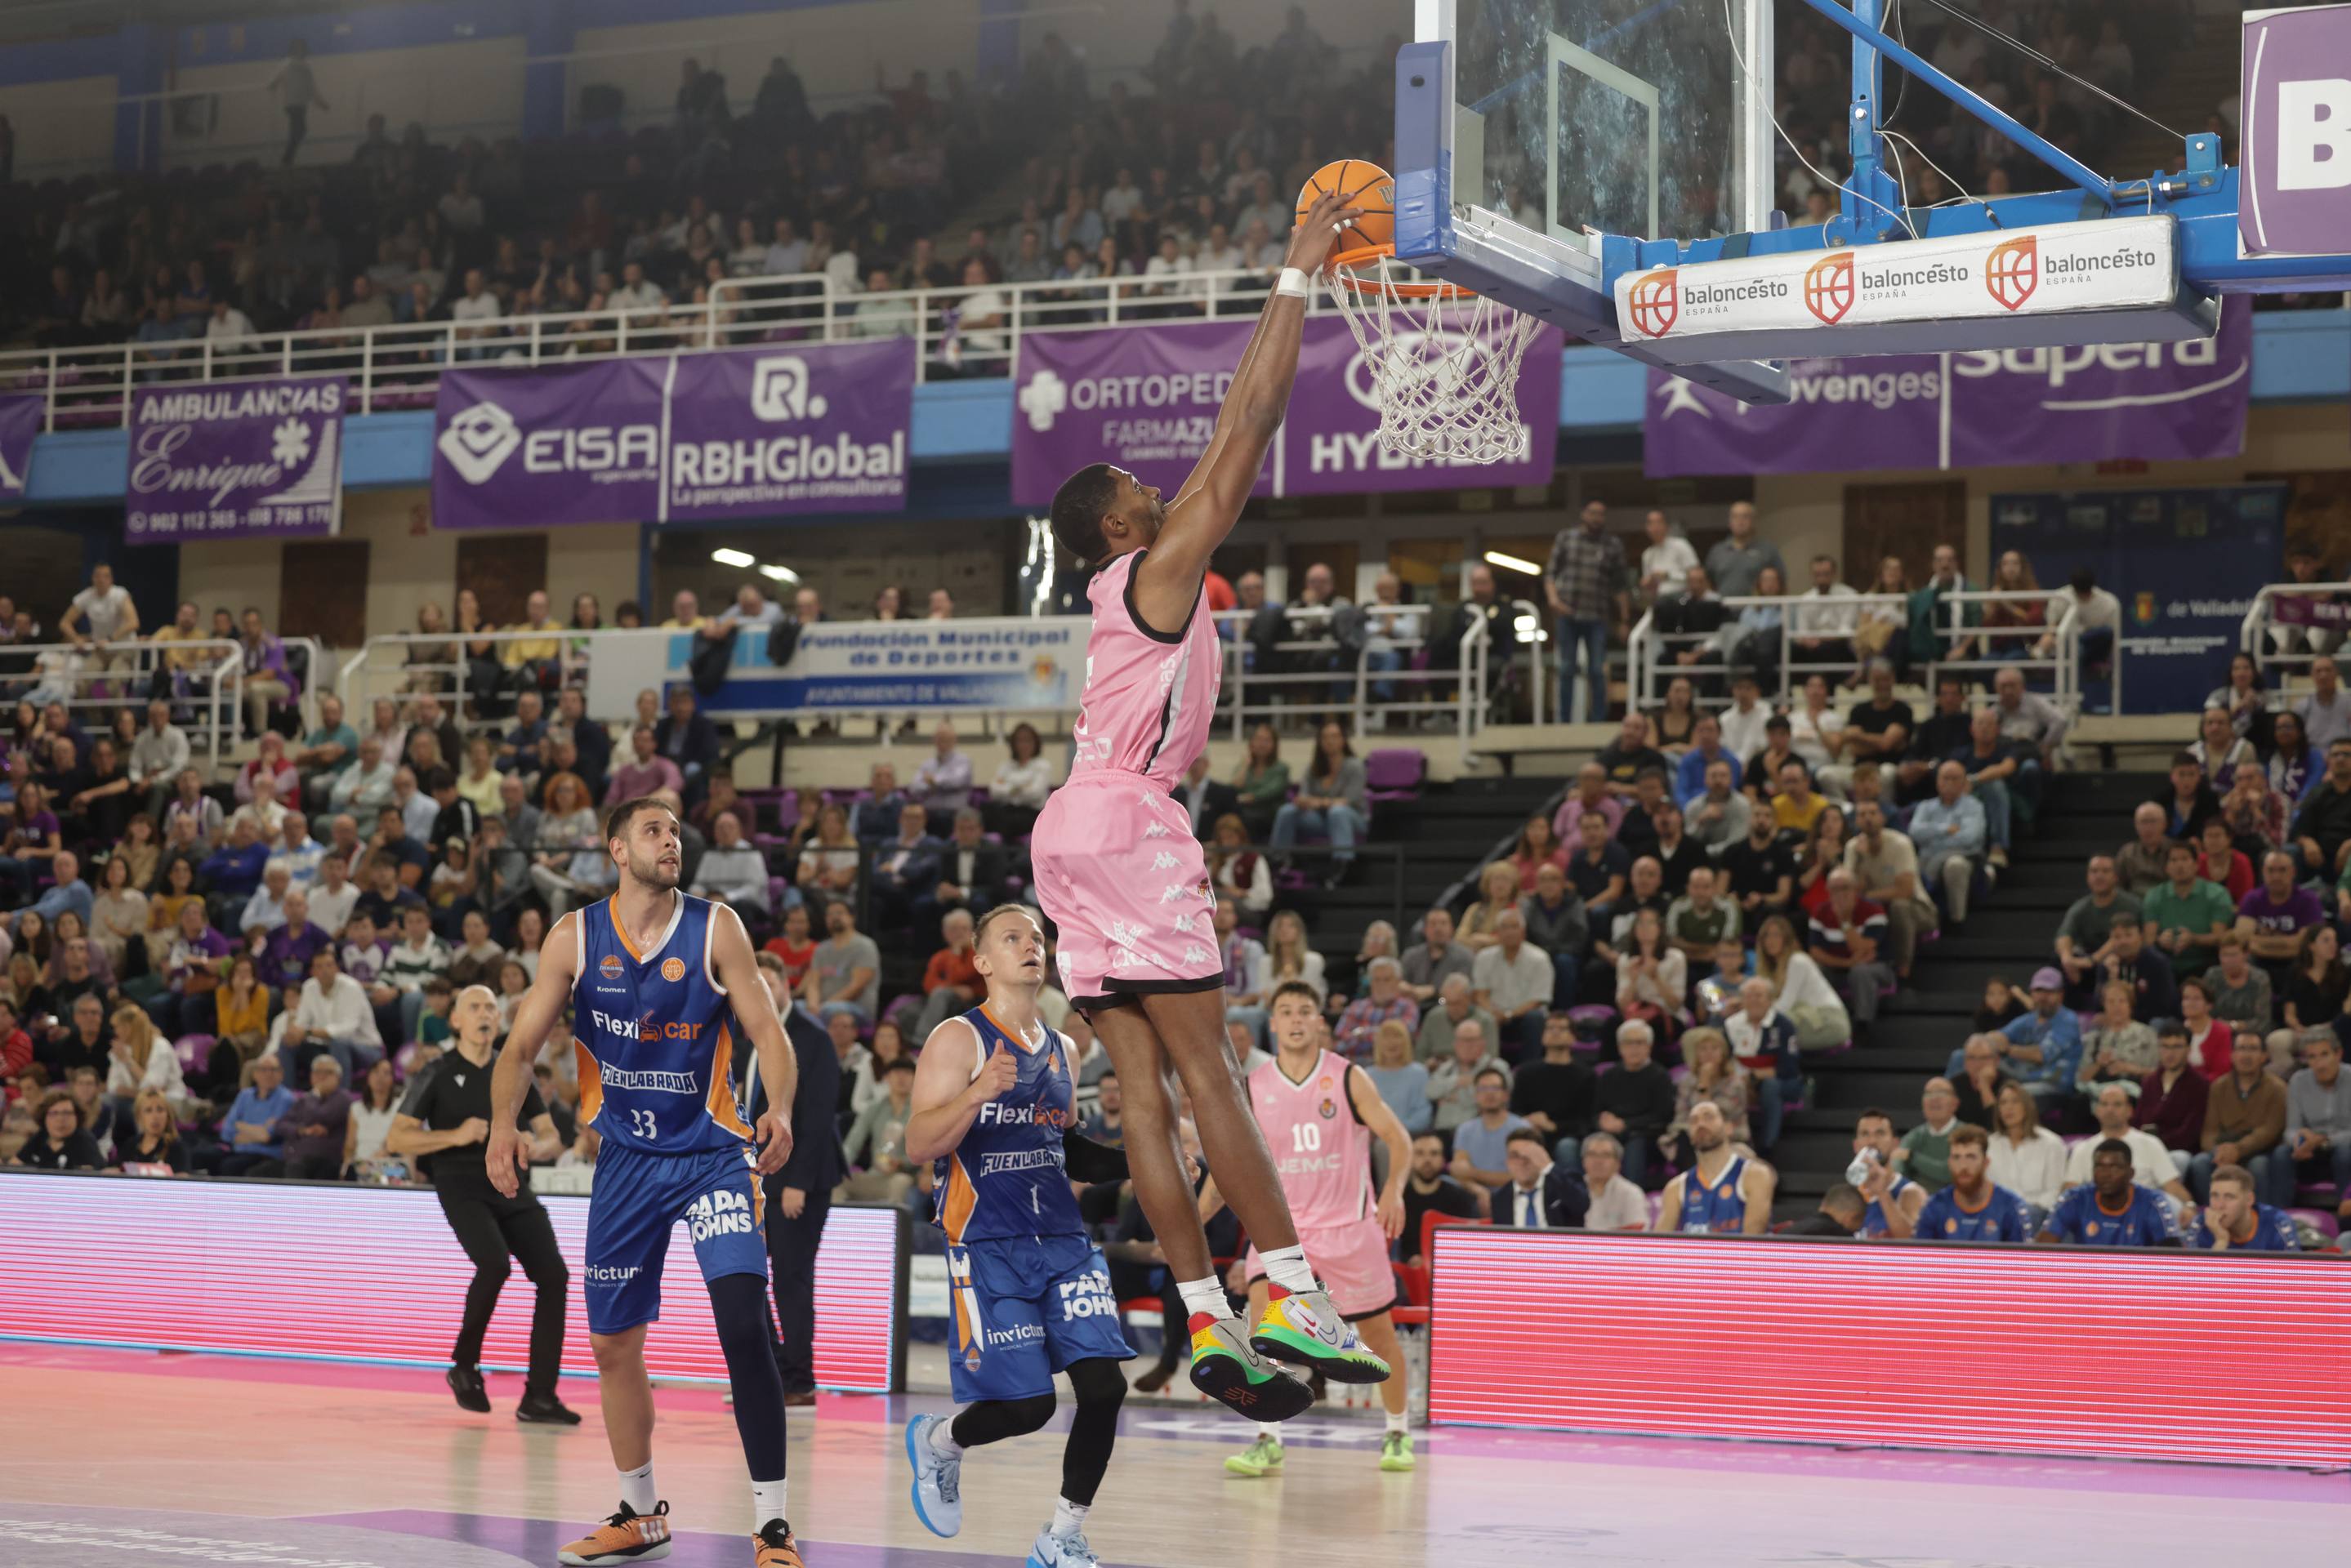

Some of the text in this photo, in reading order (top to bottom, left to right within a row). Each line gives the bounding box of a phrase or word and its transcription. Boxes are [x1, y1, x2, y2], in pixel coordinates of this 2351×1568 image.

[2046, 274, 2092, 285] ESPAÑA
[1863, 289, 1907, 301] ESPAÑA
[1685, 305, 1729, 316] ESPAÑA
[139, 383, 341, 424] AMBULANCIAS
[524, 425, 658, 473] EISA
[672, 430, 904, 487] RBHGlobal
[131, 424, 282, 508] Enrique
[936, 627, 1070, 647] Municipal
[850, 648, 1020, 667] de Deportes
[602, 1062, 698, 1094] FUENLABRADA
[631, 1108, 658, 1140] 33
[1291, 1122, 1321, 1152] 10
[1030, 1184, 1040, 1214] 1
